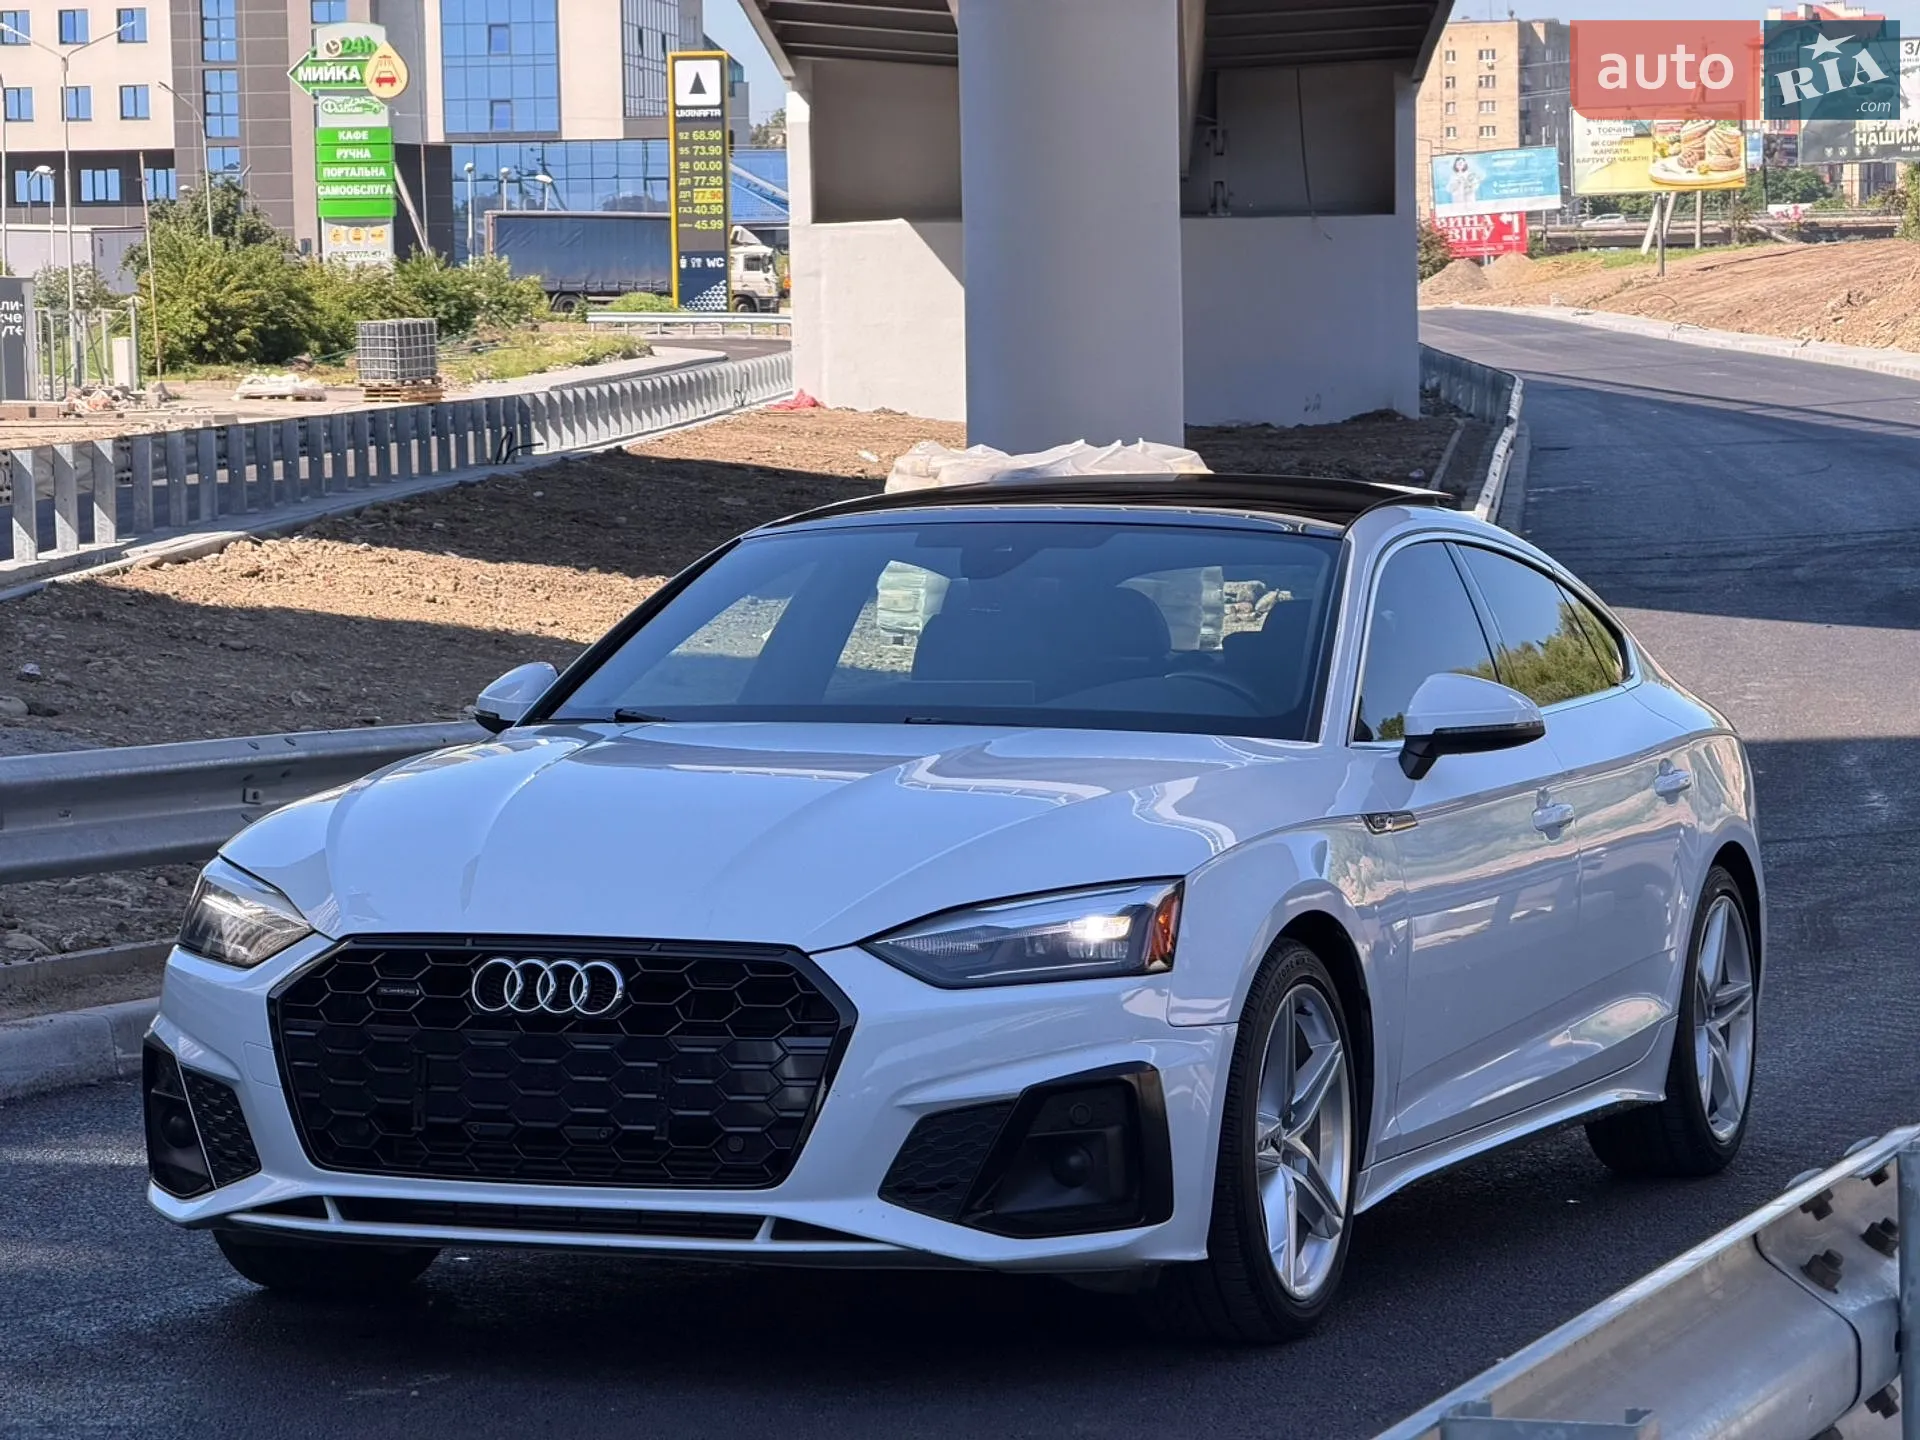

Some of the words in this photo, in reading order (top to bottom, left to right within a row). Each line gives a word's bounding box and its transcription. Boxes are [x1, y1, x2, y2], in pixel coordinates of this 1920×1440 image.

[297, 62, 362, 81] МИЙКА
[338, 130, 369, 141] КАФЕ
[692, 130, 722, 141] 68.90
[336, 148, 371, 159] РУЧНА
[692, 145, 722, 156] 73.90
[693, 160, 723, 171] 00.00
[322, 166, 387, 178] ПОРТАЛЬНА
[692, 175, 723, 187] 77.90
[317, 183, 394, 196] САМООБСЛУГА
[694, 204, 723, 215] 40.90
[694, 219, 724, 230] 45.99
[706, 256, 725, 268] WC
